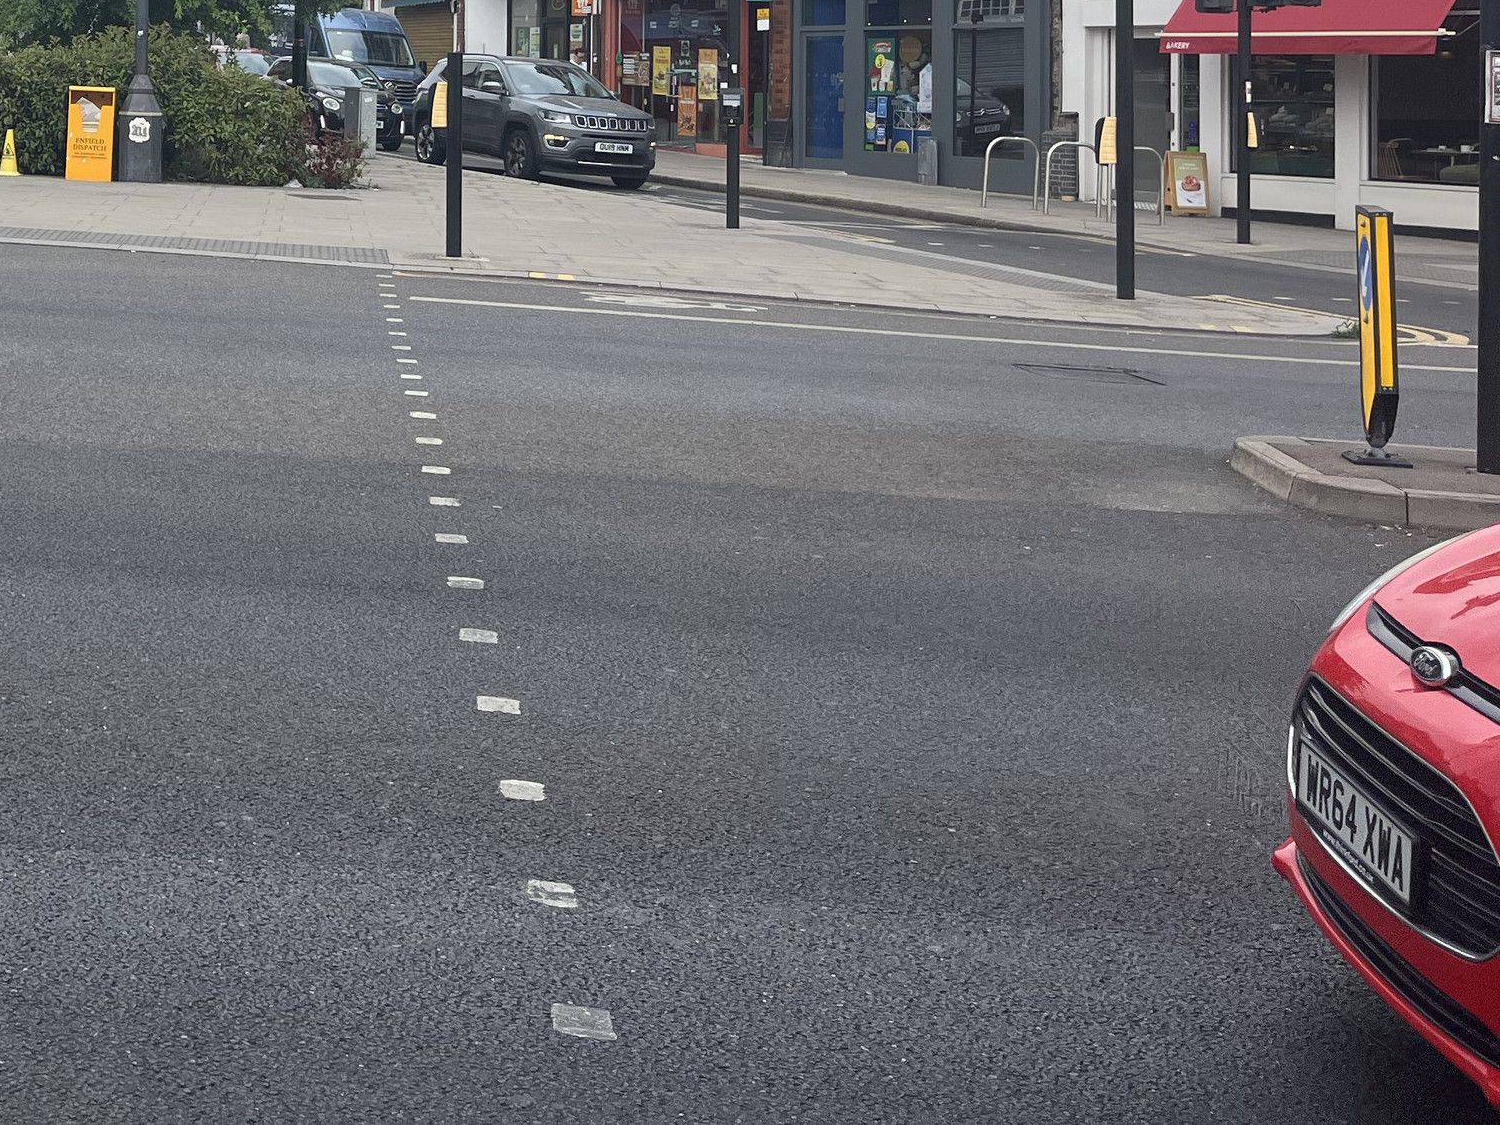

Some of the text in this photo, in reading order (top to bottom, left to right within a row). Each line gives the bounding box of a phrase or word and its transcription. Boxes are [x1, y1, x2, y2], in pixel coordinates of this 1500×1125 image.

[1165, 41, 1190, 50] BAKERY
[76, 137, 105, 145] ENFIELD
[73, 144, 107, 152] DISPATCH
[1415, 650, 1439, 676] Ford
[1306, 754, 1404, 893] WR64 XWA
